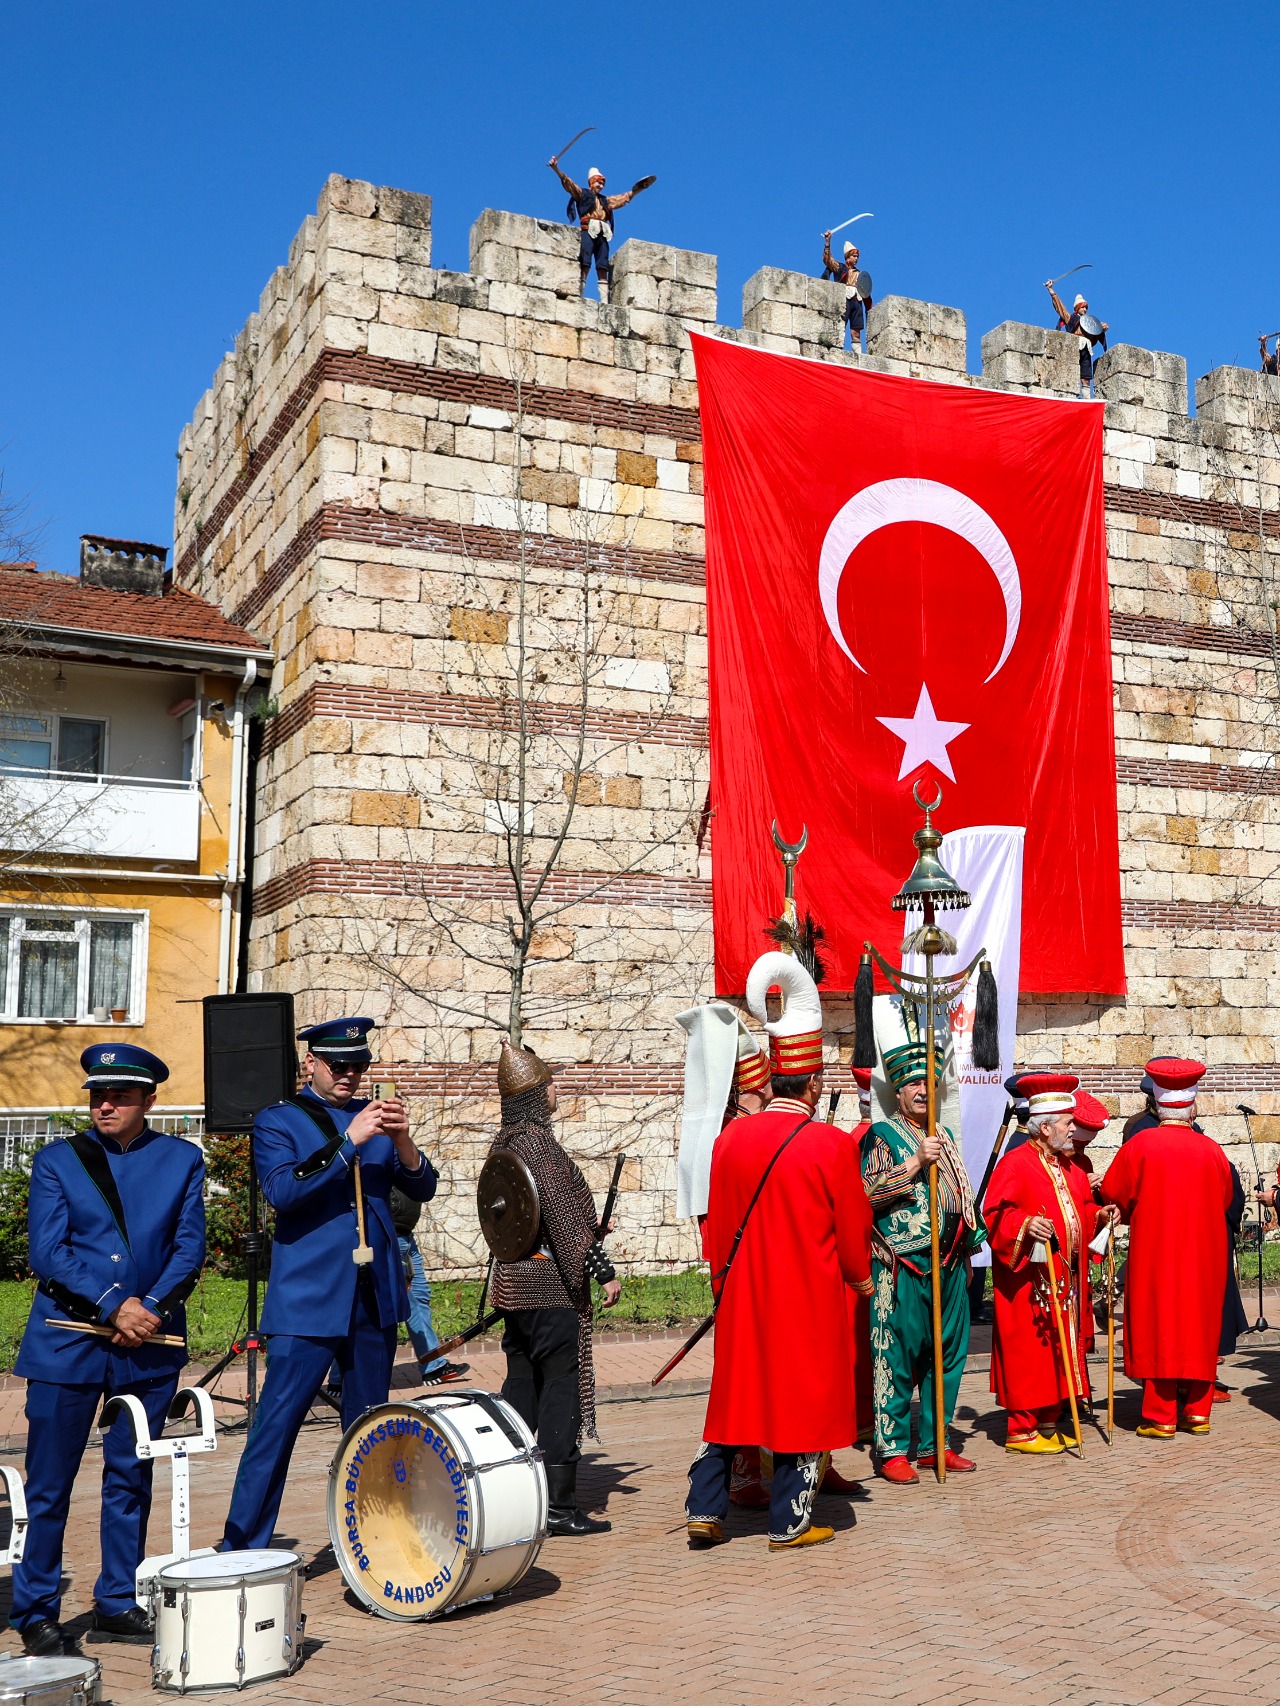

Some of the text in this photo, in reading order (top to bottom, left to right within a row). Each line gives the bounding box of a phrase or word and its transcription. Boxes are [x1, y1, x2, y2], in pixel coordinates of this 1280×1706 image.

[957, 1073, 1003, 1085] VALİLİĞİ
[345, 1413, 423, 1493] BÜYÜKŞEHİR
[345, 1499, 370, 1571] BURSA
[383, 1565, 452, 1604] BANDOSU
